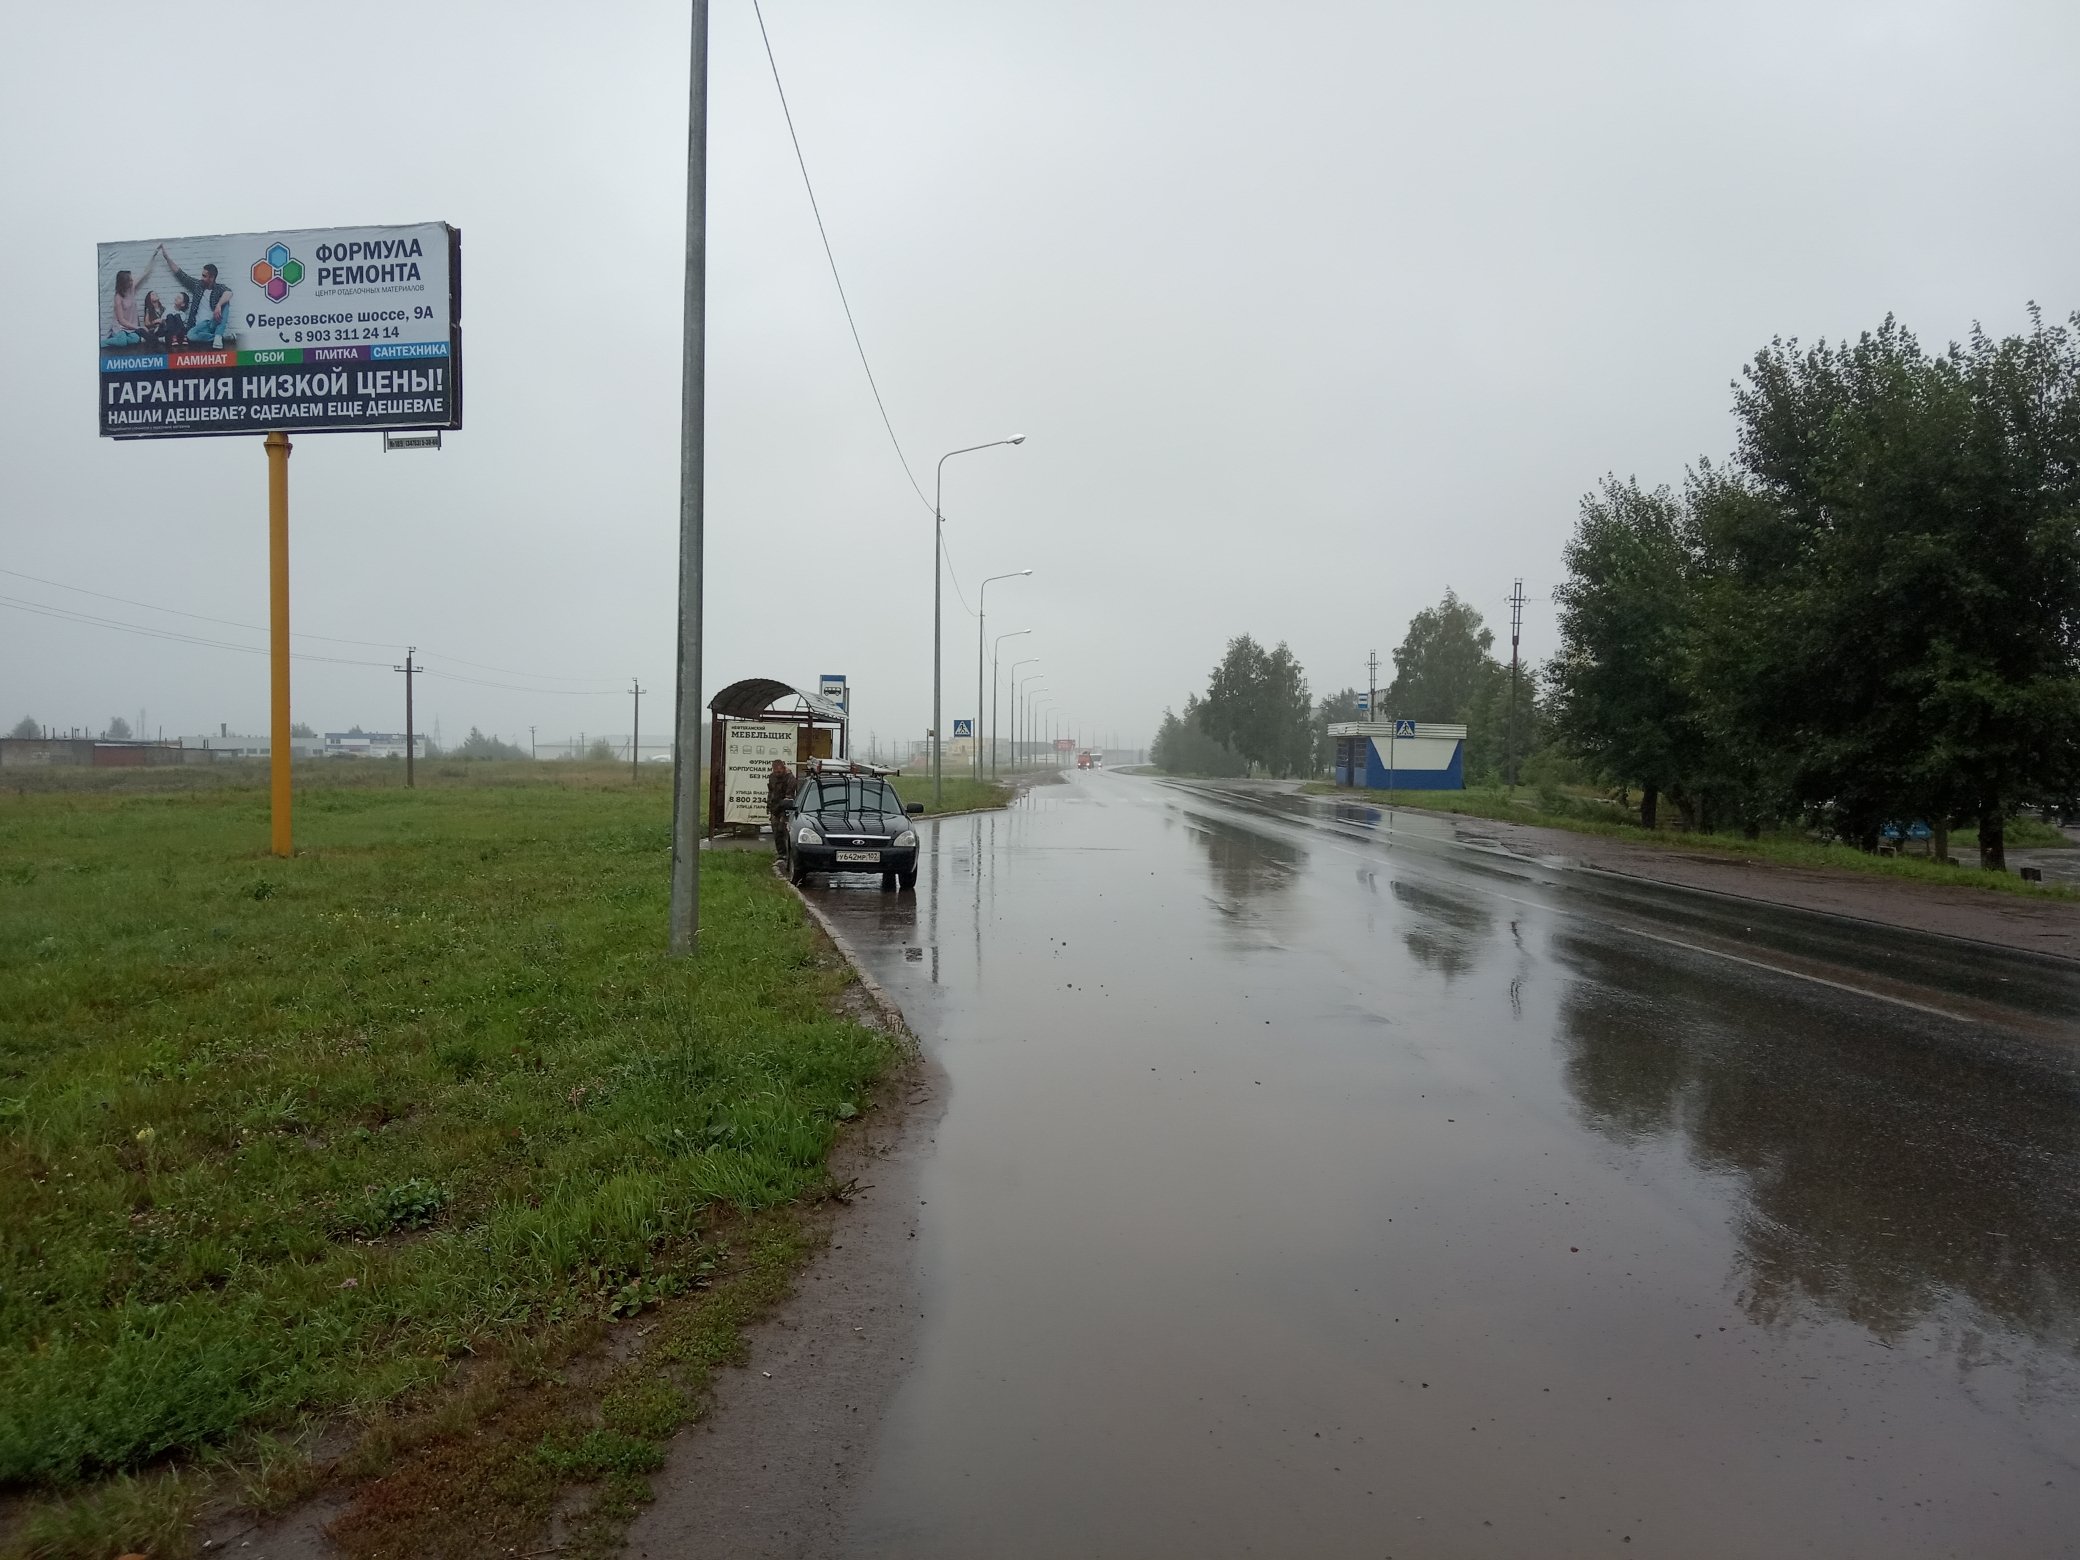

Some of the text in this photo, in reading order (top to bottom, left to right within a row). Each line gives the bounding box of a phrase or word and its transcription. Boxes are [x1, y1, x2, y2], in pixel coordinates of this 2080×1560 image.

[315, 238, 423, 263] ФОРМУЛА
[318, 262, 421, 286] РЕМОНТА
[315, 284, 425, 297] ЦЕНТР ОТДЕЛОЧНЫХ МАТЕРИАЛОВ
[258, 306, 434, 329] Березовское шоссе, 9А
[294, 326, 400, 342] 8 903 311 24 14
[254, 351, 285, 363] ОБОИ
[315, 348, 359, 361] ПЛИТКА
[373, 344, 448, 358] САНТЕХНИКА
[106, 357, 164, 370] ЛИНОЛЕУМ
[176, 354, 228, 366] ЛАМИНАТ
[108, 366, 443, 405] ГАРАНТИЯ НИЗКОЙ ЦЕНЫ!
[108, 398, 444, 425] НАШЛИ ДЕШЕВЛЕ? СДЕЛАЕМ ЕЩЕ ДЕШЕВЛЕ
[731, 731, 792, 740] МЕБЕЛЬЩИК
